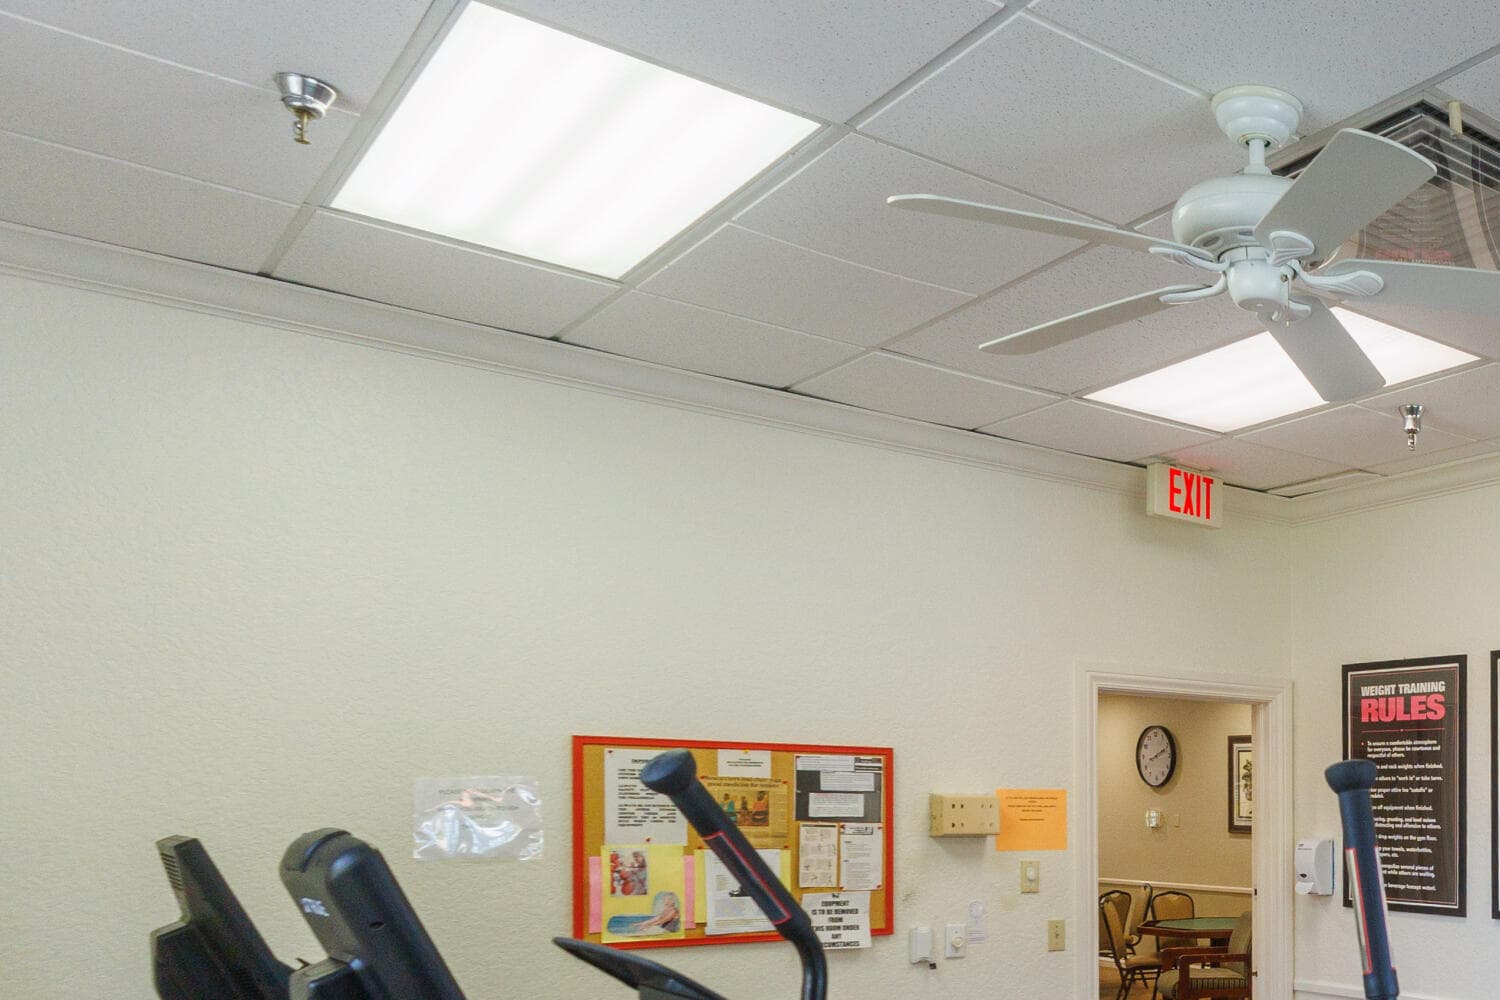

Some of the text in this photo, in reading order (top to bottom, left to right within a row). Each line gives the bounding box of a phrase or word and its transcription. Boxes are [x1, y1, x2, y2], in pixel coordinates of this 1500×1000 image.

[1169, 467, 1213, 519] EXIT
[1361, 681, 1445, 697] WEIGHT TRAINING
[1361, 693, 1446, 722] RULES
